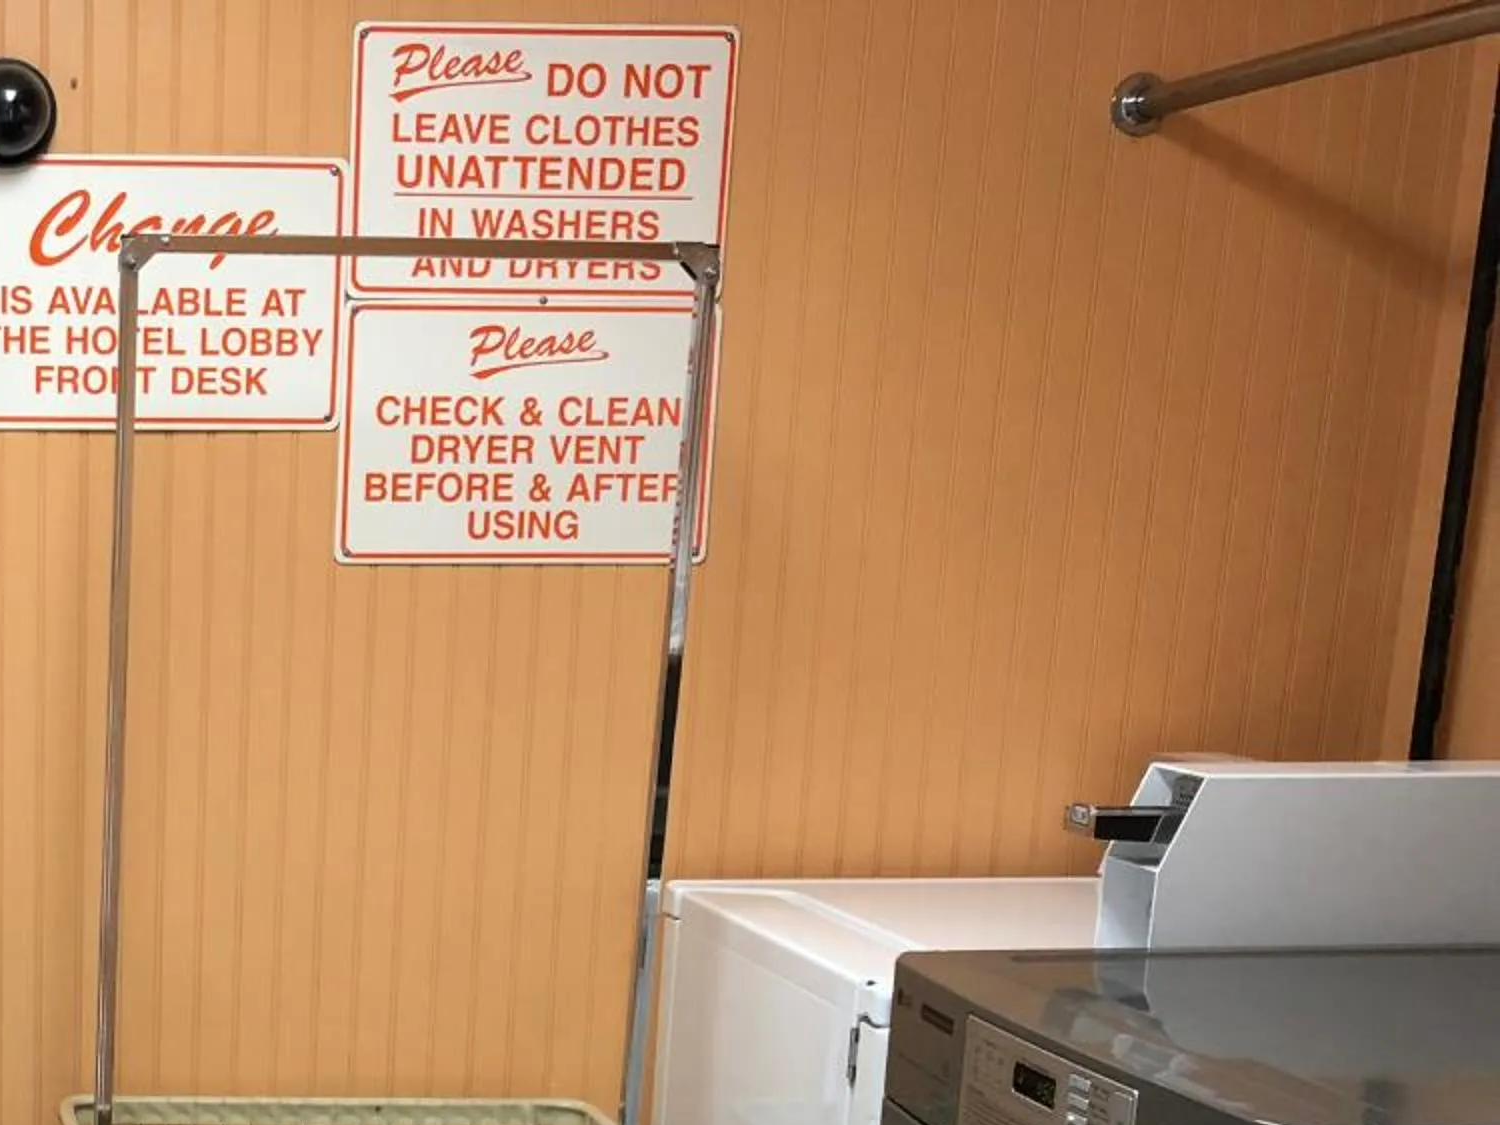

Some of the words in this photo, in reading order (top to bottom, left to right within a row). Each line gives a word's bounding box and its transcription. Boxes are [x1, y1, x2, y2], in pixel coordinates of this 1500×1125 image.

[392, 43, 526, 90] Please
[546, 63, 607, 98] DO
[623, 63, 712, 99] NOT
[392, 112, 511, 144] LEAVE
[525, 114, 700, 147] CLOTHES
[397, 154, 687, 192] UNATTENDED
[418, 207, 453, 238] IN
[471, 209, 660, 241] WASHERS
[411, 256, 491, 278] AND
[508, 258, 662, 281] DRYERS
[1, 286, 32, 315] IS
[47, 286, 247, 316] AVAABLE
[261, 288, 307, 316] AT
[66, 326, 186, 355] HOEL
[201, 328, 323, 357] LOBBY
[469, 325, 600, 370] Please
[171, 367, 268, 395] DESK
[375, 395, 505, 427] CHECK
[519, 396, 543, 427] &
[558, 396, 682, 427] CLEAN
[411, 435, 534, 464] DRYER
[550, 435, 645, 465] VENT
[364, 472, 514, 502] BEFORE
[529, 473, 552, 502] &
[467, 510, 580, 541] USING
